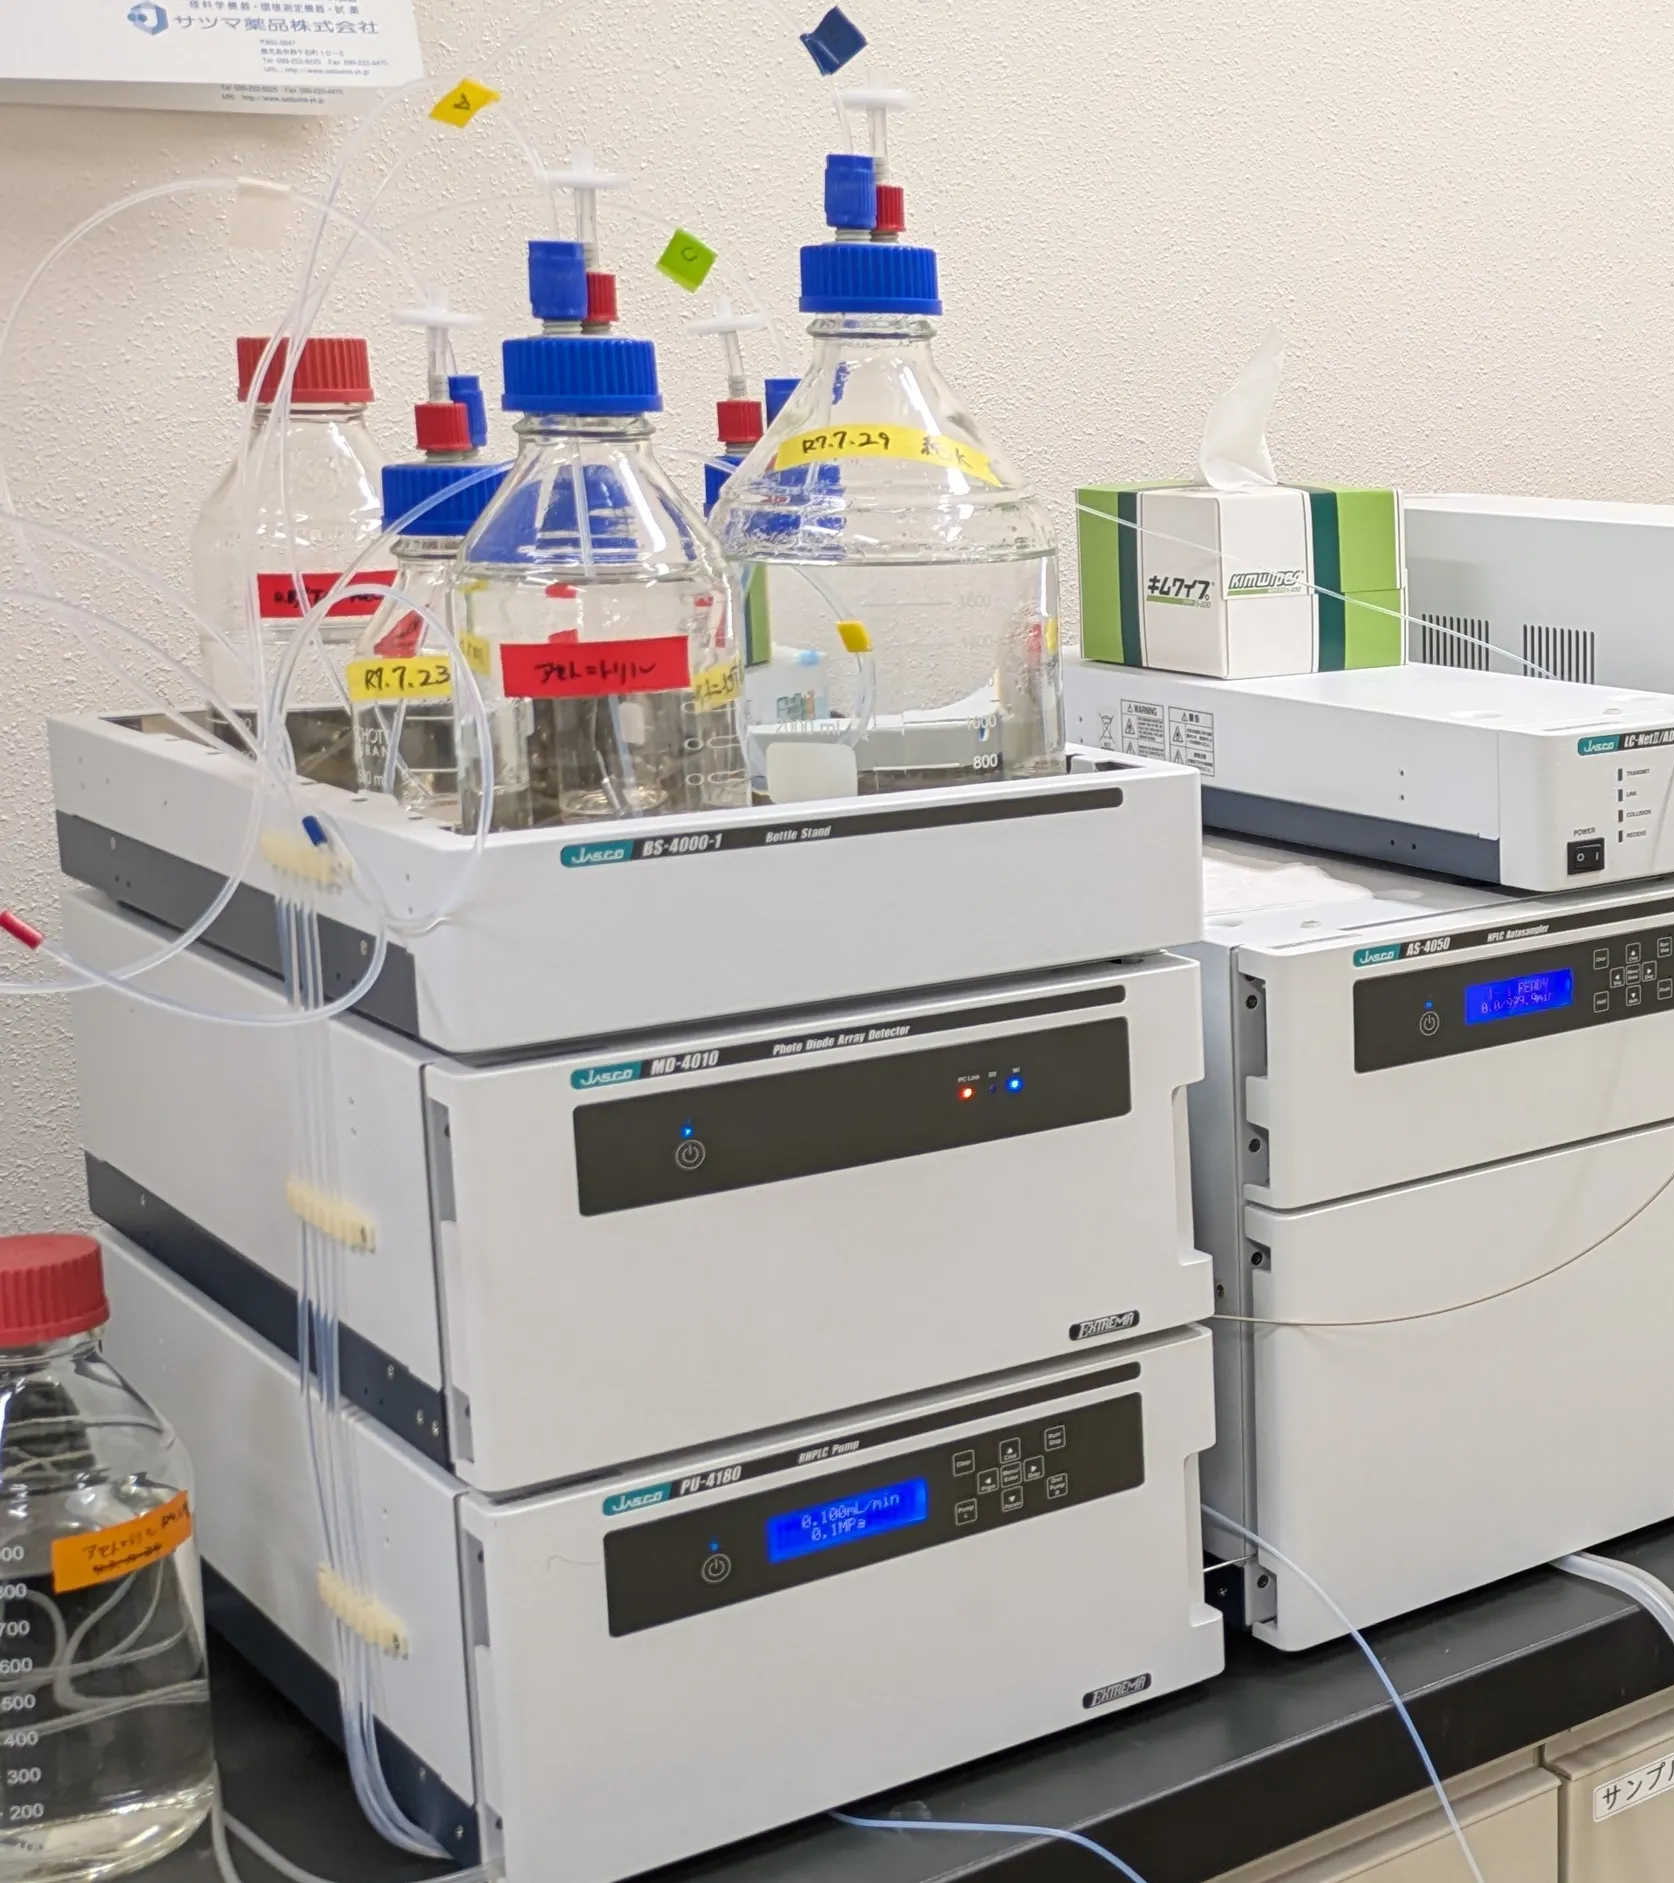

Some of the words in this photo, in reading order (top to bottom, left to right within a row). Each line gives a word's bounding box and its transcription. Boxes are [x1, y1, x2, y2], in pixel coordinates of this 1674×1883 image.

[174, 15, 380, 35] サツマ薬品株式会社
[1147, 575, 1211, 600] キムワイプ
[1583, 740, 1615, 753] JASCO
[973, 755, 999, 769] 800
[642, 833, 723, 857] BS-4000-1
[765, 829, 797, 843] Bottle
[801, 825, 831, 840] Stand
[1573, 827, 1596, 837] POWER
[571, 847, 625, 864] JASCO
[1406, 937, 1451, 957] AS-4050
[1487, 931, 1505, 943] HPLC
[1506, 924, 1549, 942] Autosampler
[1359, 950, 1395, 965] JASCO
[650, 1050, 720, 1075] MD-4010
[773, 1042, 802, 1056] Photo
[805, 1037, 835, 1051] Diode
[837, 1032, 866, 1047] Array
[868, 1025, 911, 1041] Detector
[579, 1068, 632, 1086] JASCO
[1077, 1311, 1135, 1340] EXTREMA
[680, 1466, 742, 1495] PU-4180
[831, 1440, 861, 1457] Pump
[612, 1490, 663, 1512] JASCO
[801, 1493, 900, 1529] 0.100mL/min
[811, 1517, 867, 1541] 0.1MPa
[0, 1544, 24, 1561] 00
[0, 1657, 33, 1673] 600
[1089, 1675, 1147, 1706] EXTREMA
[1, 1694, 36, 1710] 500
[4, 1730, 39, 1747] 400
[7, 1767, 42, 1784] 300
[10, 1803, 44, 1820] 200
